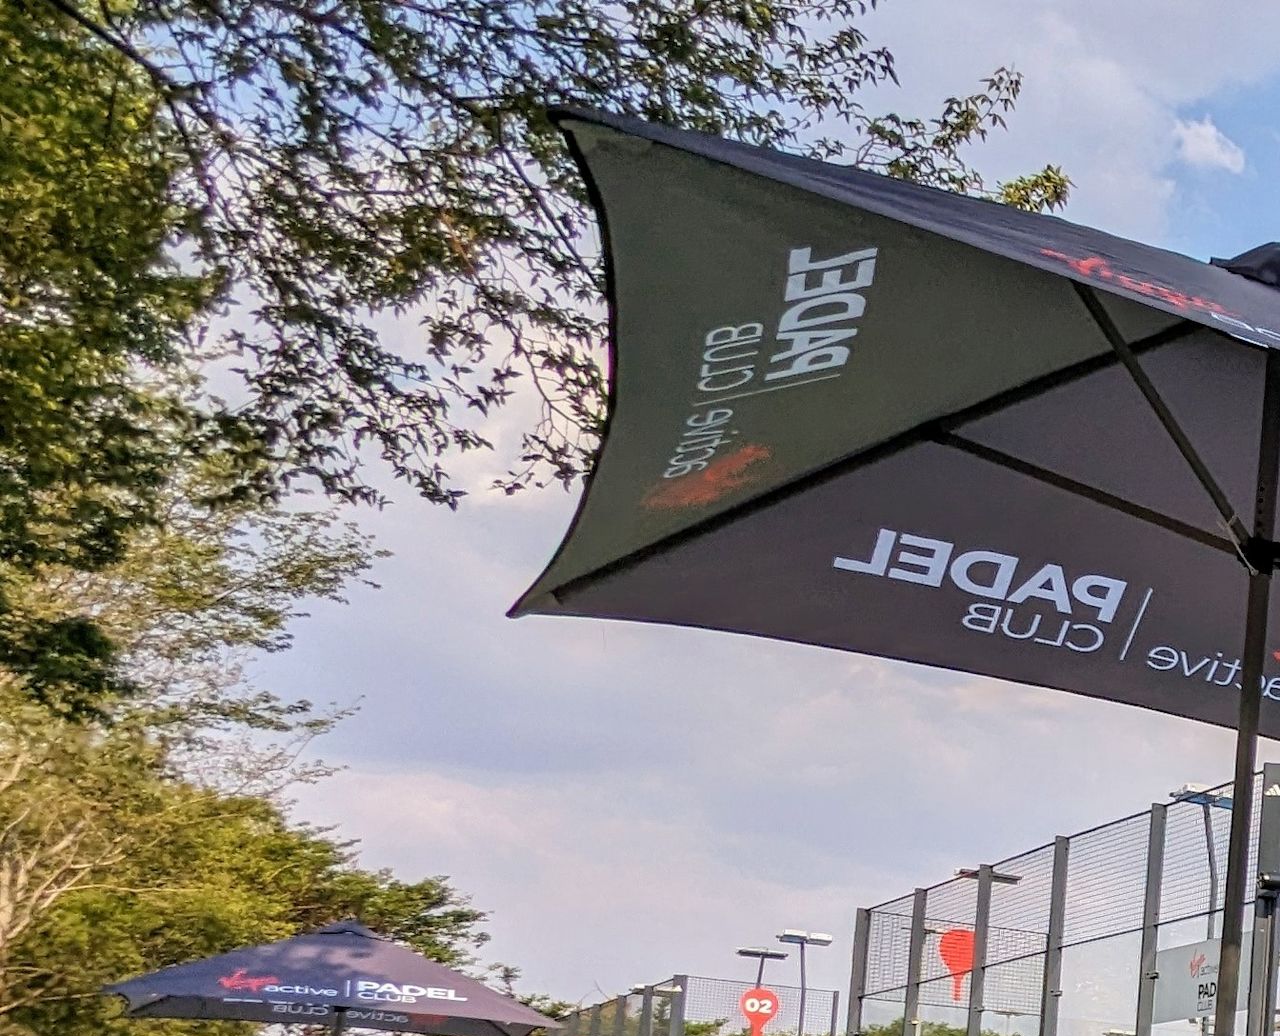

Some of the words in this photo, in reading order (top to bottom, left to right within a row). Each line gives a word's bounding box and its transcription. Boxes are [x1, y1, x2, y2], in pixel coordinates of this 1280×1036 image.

[264, 984, 338, 997] active
[357, 980, 468, 1002] PADEL
[357, 991, 416, 1004] CLUB
[745, 998, 772, 1013] 02
